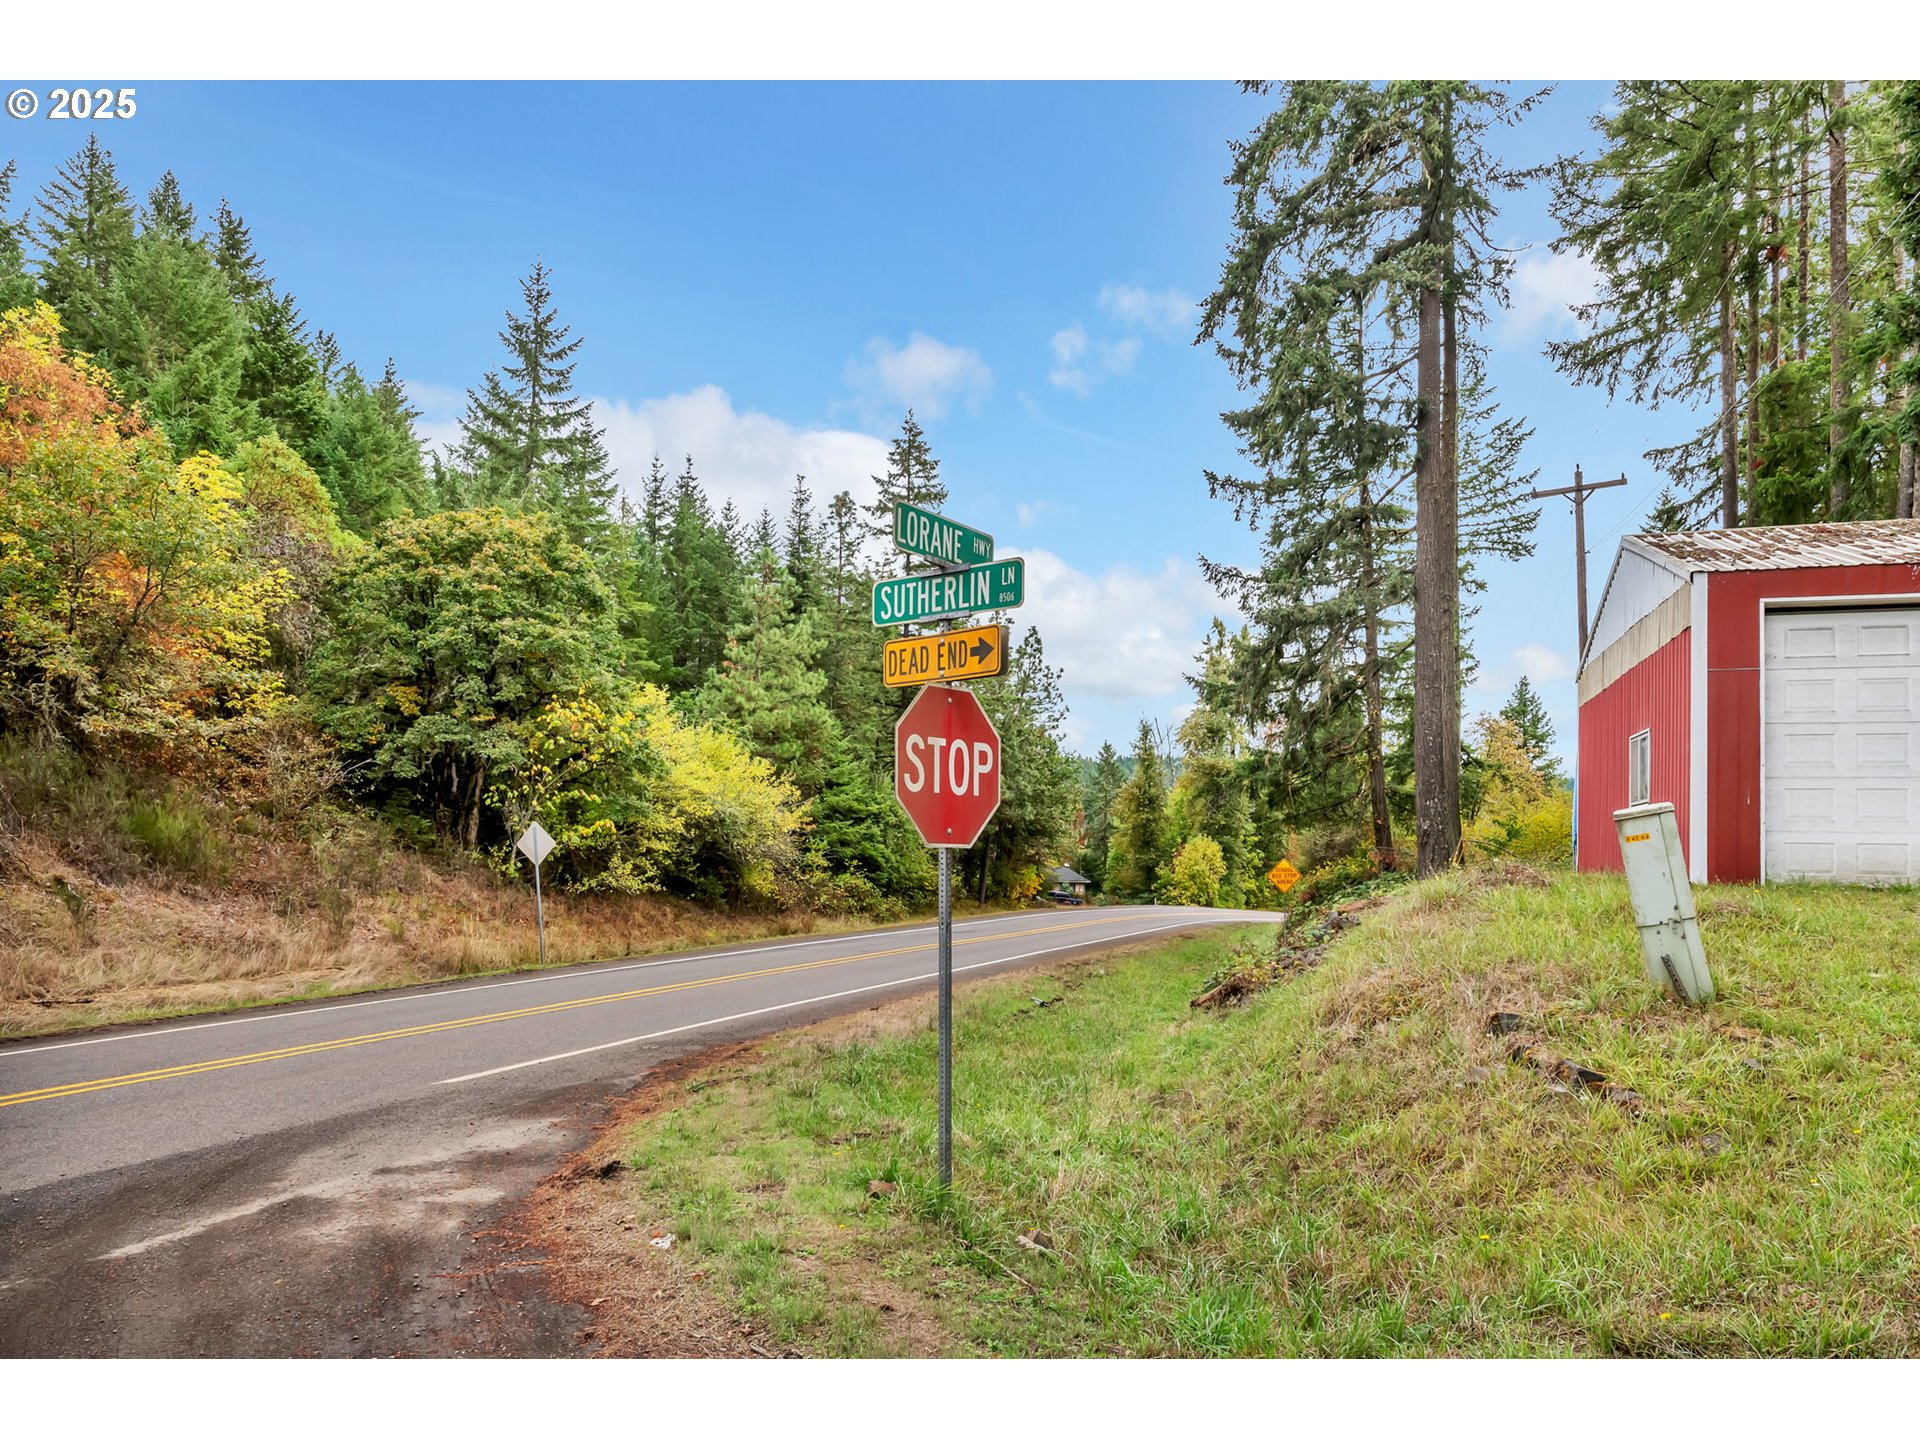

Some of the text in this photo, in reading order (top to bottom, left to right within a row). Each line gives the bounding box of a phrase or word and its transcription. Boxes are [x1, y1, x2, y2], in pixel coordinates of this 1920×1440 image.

[898, 507, 992, 564] LORANE HWY
[880, 566, 1016, 620] SUTHERLIN LN
[998, 592, 1015, 603] 8506
[888, 639, 968, 677] DEAD END
[903, 733, 994, 797] STOP
